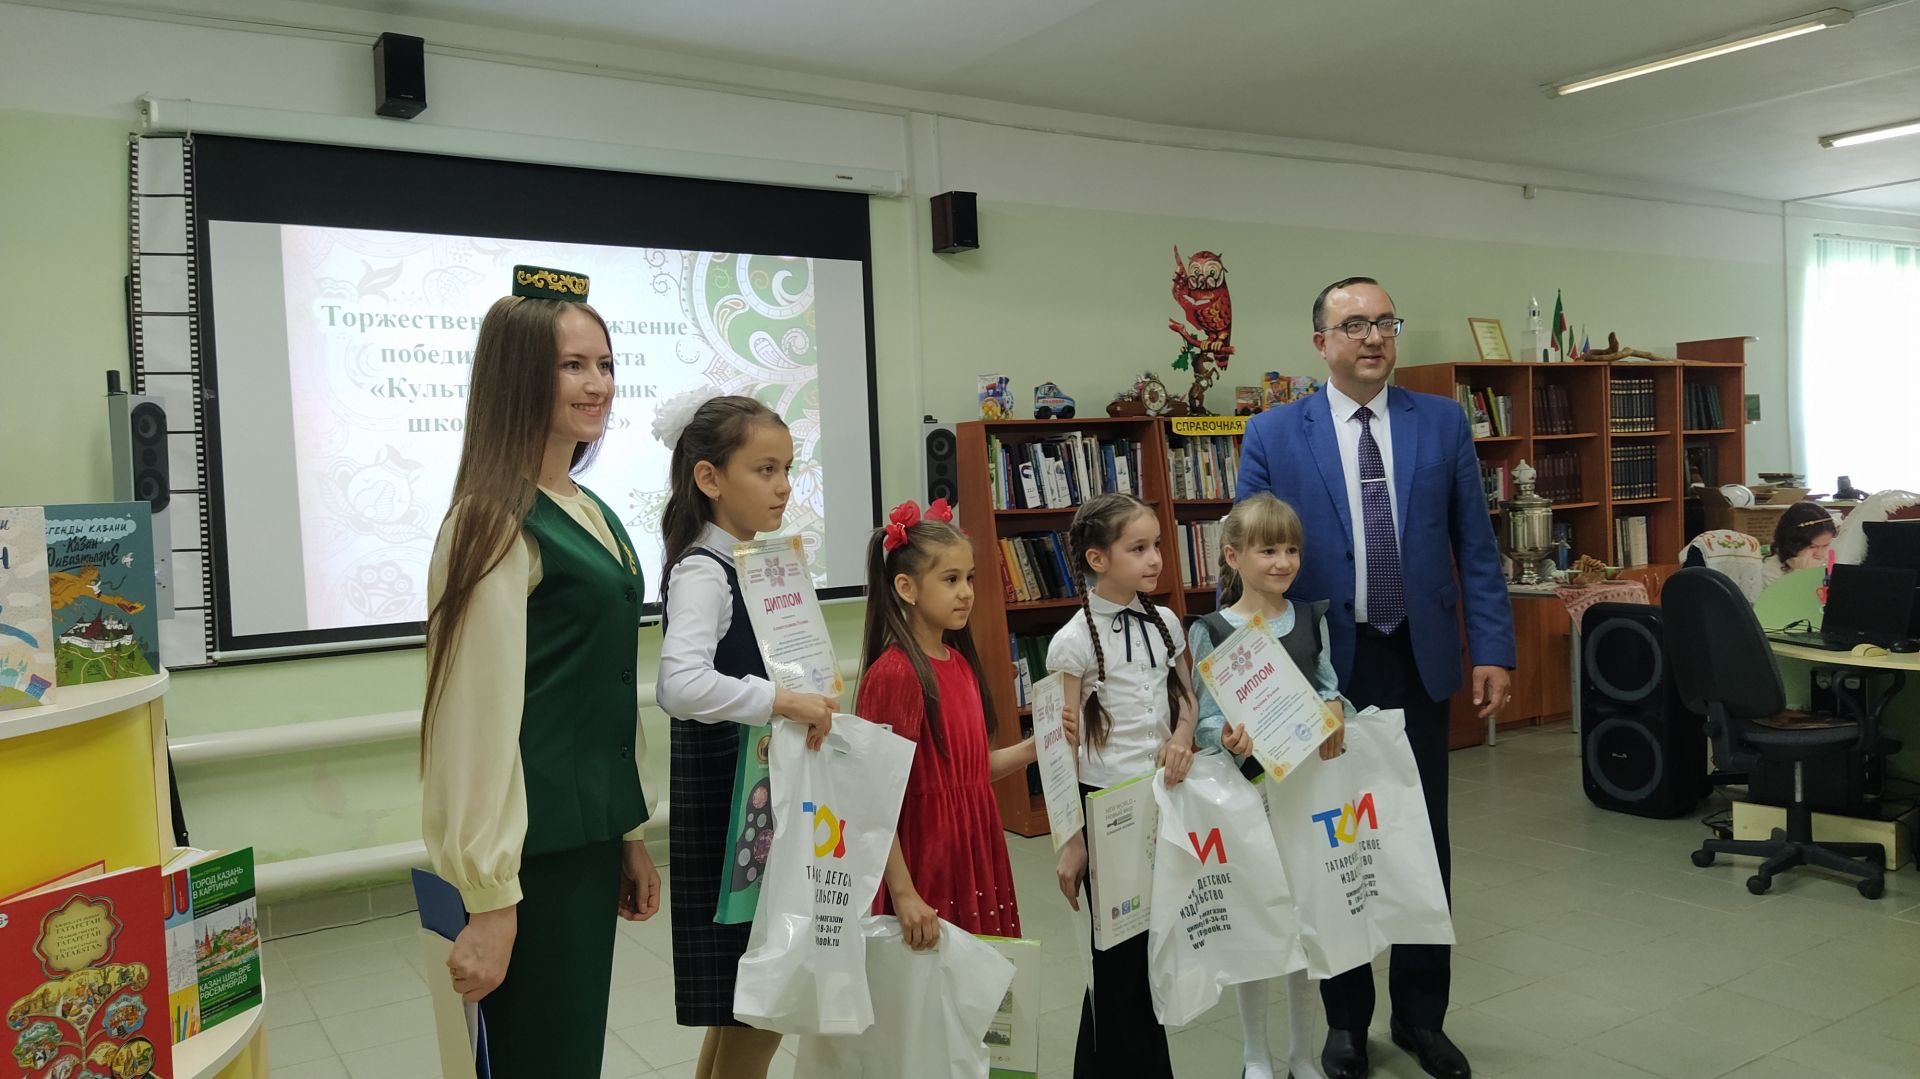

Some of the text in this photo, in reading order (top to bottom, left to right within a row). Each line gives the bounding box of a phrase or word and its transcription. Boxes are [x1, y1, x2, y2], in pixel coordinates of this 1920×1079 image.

[321, 305, 688, 335] Торжествен ждение
[381, 344, 472, 364] победи
[371, 377, 468, 403] «Культ
[1175, 421, 1243, 431] СПРАВОЧНАЯ
[45, 524, 127, 535] ГЕНДЫ КАЗАНИ
[763, 592, 803, 615] ДИПЛОМ
[1236, 662, 1276, 704] ДИПЛОМ
[192, 875, 216, 890] ГОРОД
[217, 867, 243, 881] КАЗАНЬ
[193, 876, 239, 899] В КАРТИНКАХ
[825, 870, 851, 887] ДЕТС
[1197, 872, 1232, 891] ДЕТСКОЕ
[816, 888, 849, 907] ЕЛЬСТВО
[200, 977, 221, 992] КАЗАН
